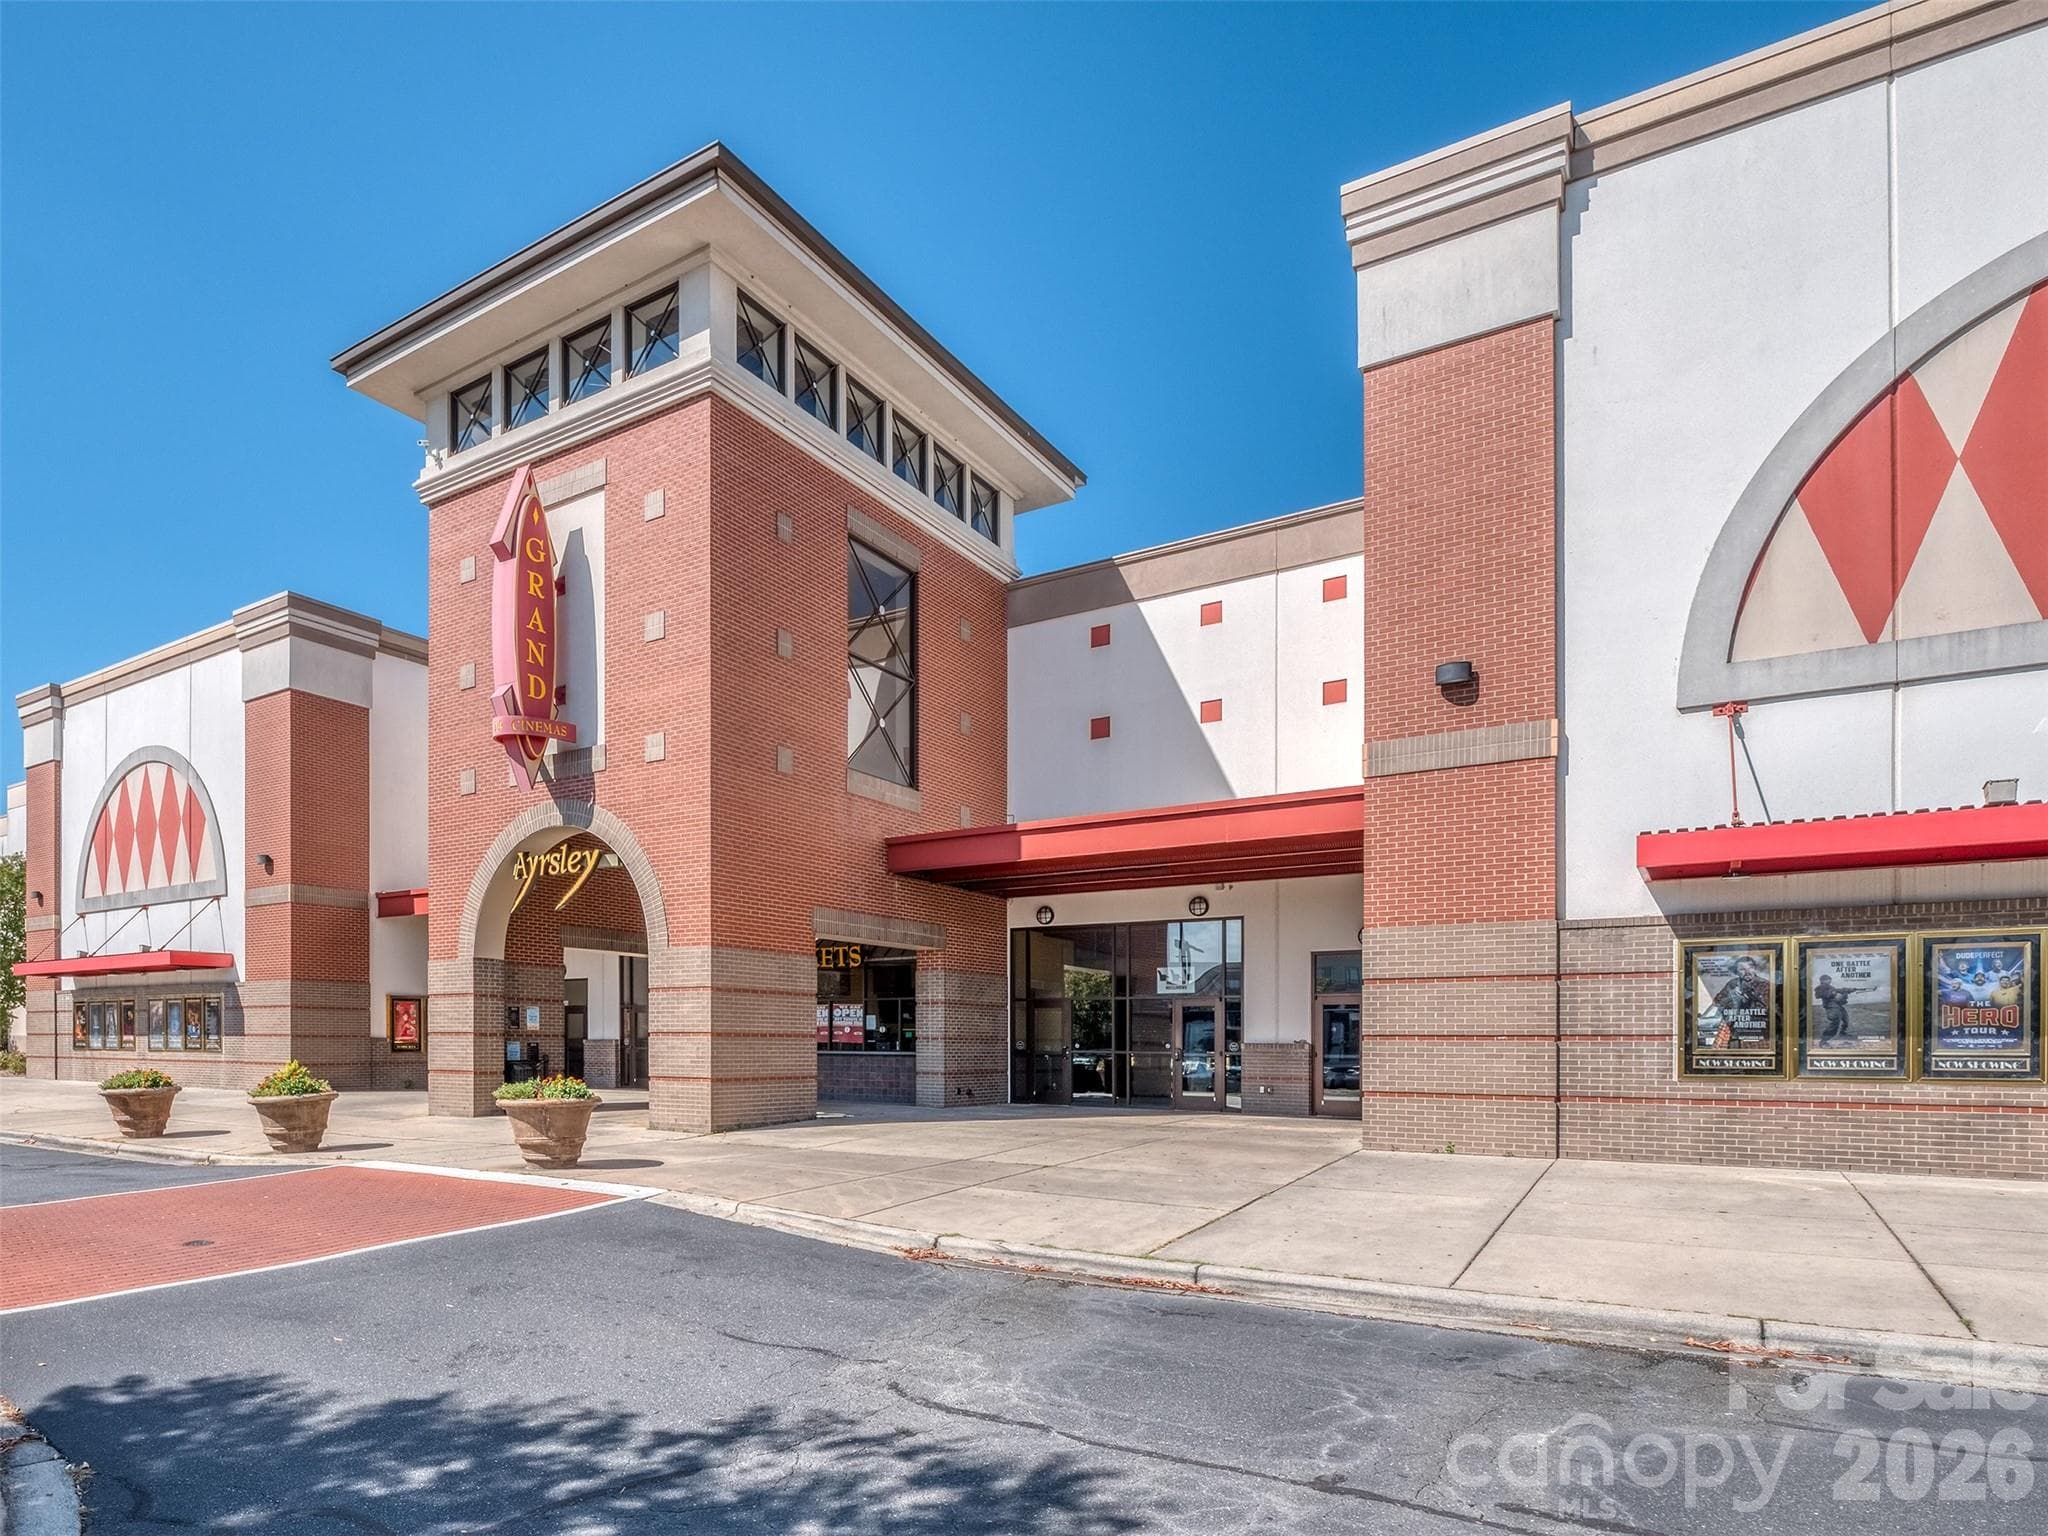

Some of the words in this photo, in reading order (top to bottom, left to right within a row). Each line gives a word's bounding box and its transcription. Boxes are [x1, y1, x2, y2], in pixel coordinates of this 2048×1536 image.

[525, 537, 546, 700] GRAND
[511, 720, 568, 737] CINEMAS
[511, 843, 600, 914] Ayrsley
[816, 945, 862, 969] ETS
[833, 1008, 864, 1018] OPEN
[1723, 1008, 1738, 1016] ONE
[1739, 1008, 1767, 1016] BATTLE
[1941, 1004, 2020, 1030] HERO
[1733, 1021, 1767, 1029] ANOTHER
[1962, 1027, 1997, 1035] TOUR
[1699, 1059, 1720, 1067] NOW
[1723, 1059, 1768, 1068] SHOWING
[1813, 1060, 1836, 1068] NOW
[1840, 1060, 1889, 1068] SHOWING
[1938, 1061, 1963, 1069] NOW
[1966, 1061, 2019, 1070] SHOWING
